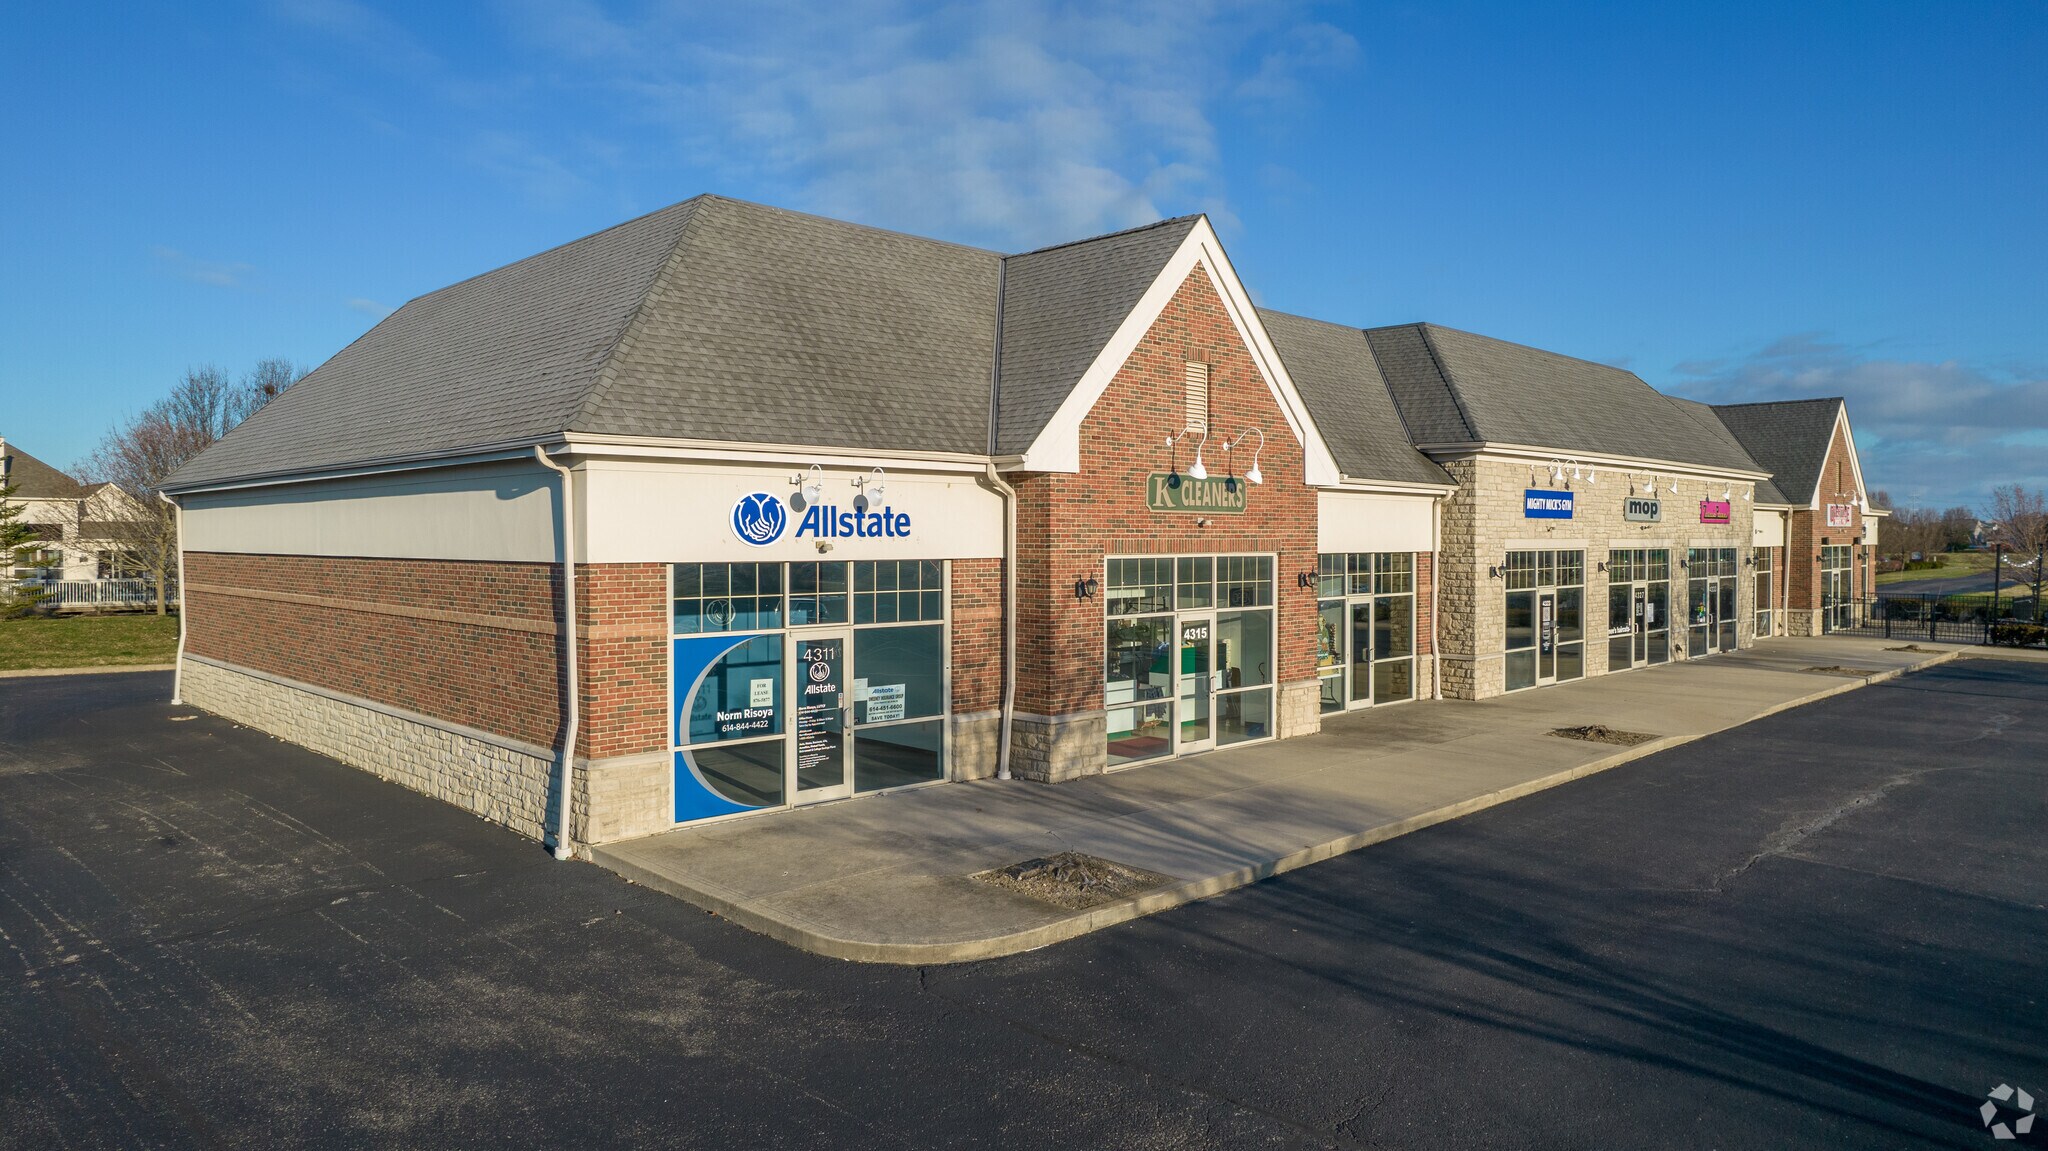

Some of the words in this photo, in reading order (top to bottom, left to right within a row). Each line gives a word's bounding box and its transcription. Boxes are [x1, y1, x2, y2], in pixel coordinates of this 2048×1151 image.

[1152, 477, 1176, 507] K
[1181, 480, 1243, 508] CLEANERS
[1527, 497, 1546, 510] MIGHTY
[1546, 498, 1561, 510] MICK'S
[1562, 499, 1572, 511] GYM
[1629, 500, 1658, 519] mop
[795, 505, 911, 538] Allstate
[1184, 627, 1207, 640] 4315
[803, 647, 834, 662] 4311
[804, 683, 836, 695] Allstate
[717, 711, 742, 722] Norm
[744, 708, 773, 719] Risoya
[722, 720, 768, 732] 614-844-4422
